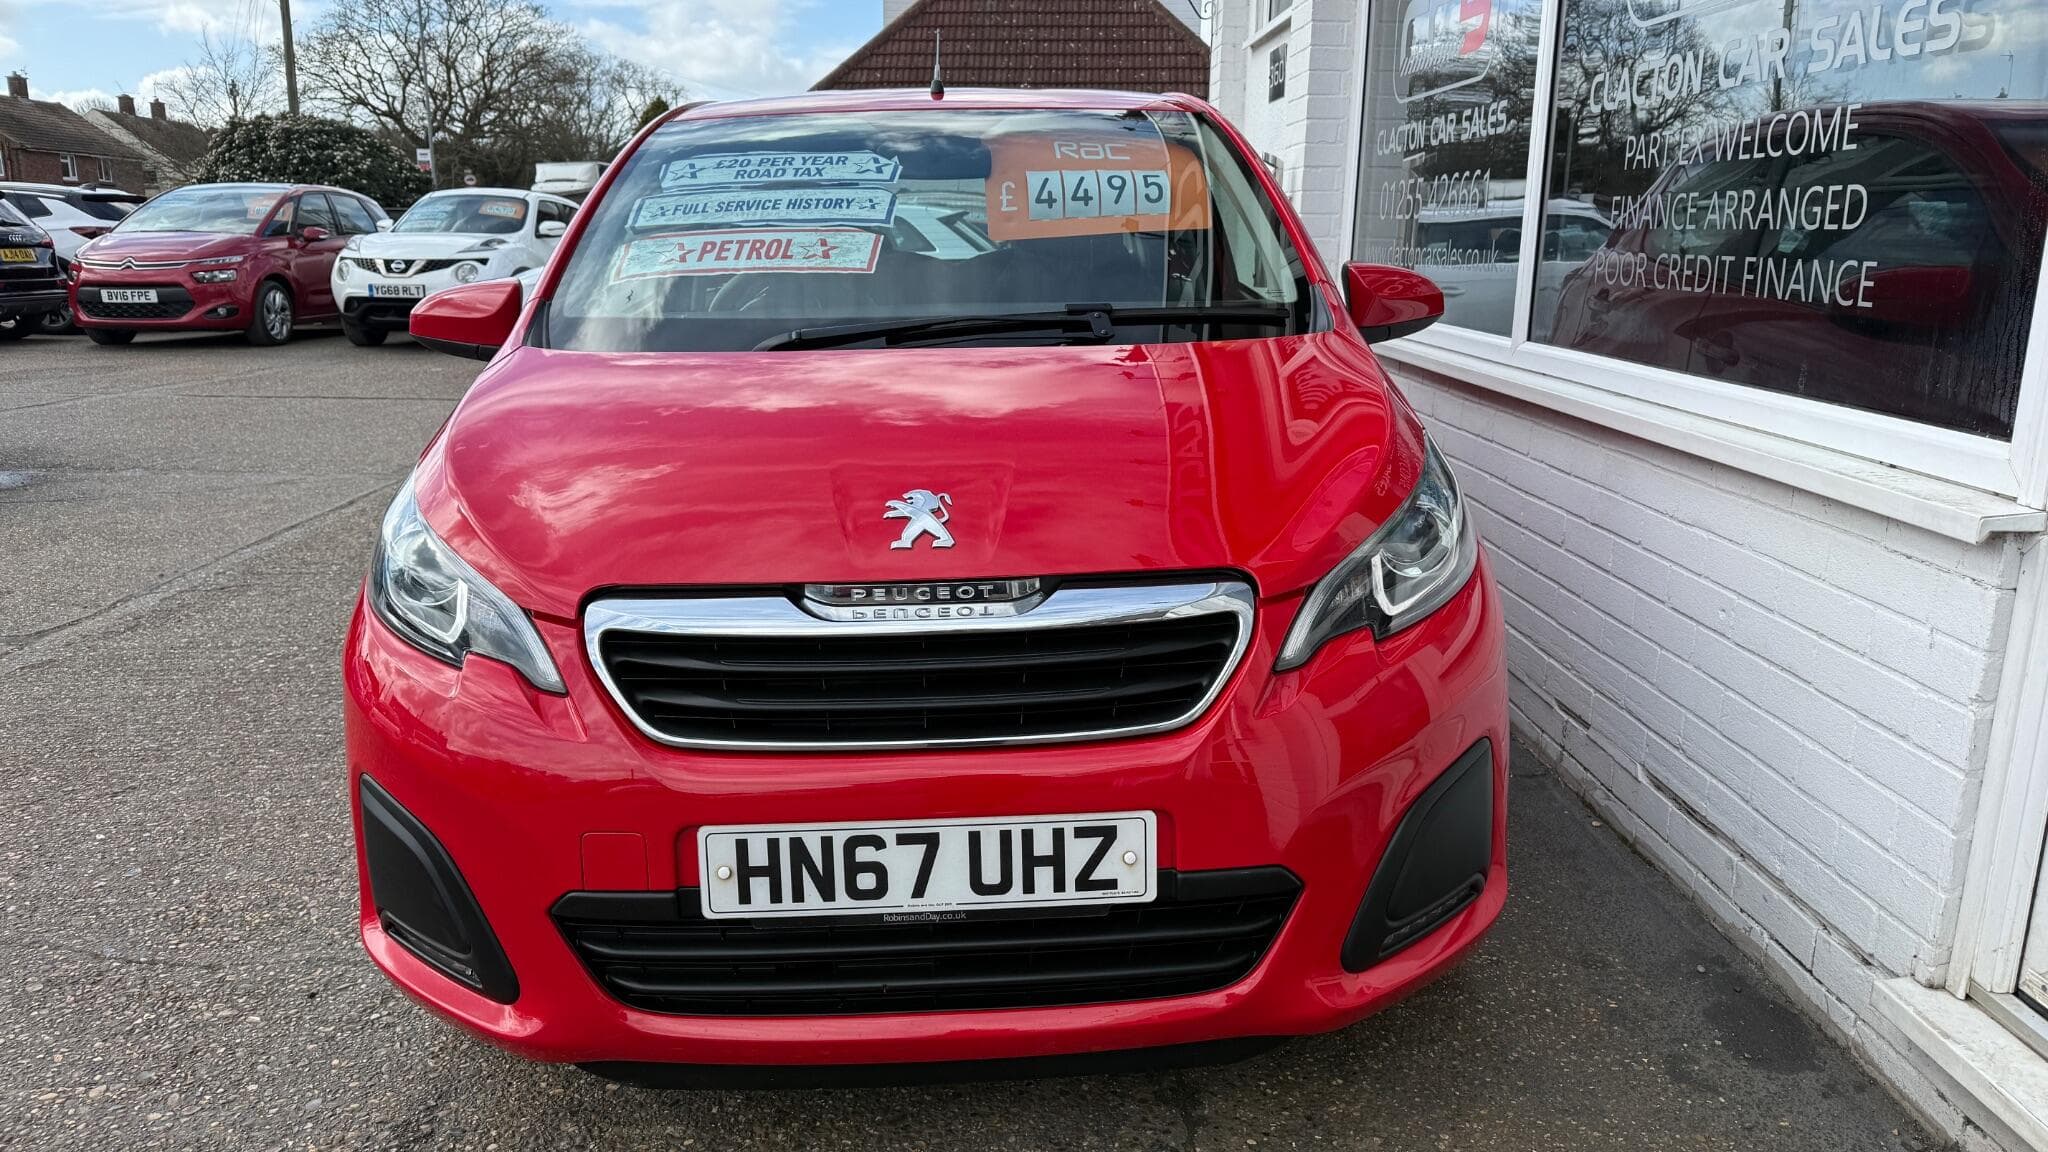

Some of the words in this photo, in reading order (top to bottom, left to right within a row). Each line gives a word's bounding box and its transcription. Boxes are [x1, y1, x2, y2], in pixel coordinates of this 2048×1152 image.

[1590, 50, 1704, 113] CLACTON
[1718, 27, 1792, 88] CAR
[1807, 0, 1963, 74] SALES
[1377, 119, 1427, 156] CLACTON
[1430, 112, 1457, 146] CAR
[1460, 100, 1508, 143] SALES
[1624, 128, 1672, 170] PART
[1679, 121, 1704, 165] EX
[1713, 103, 1864, 162] WELCOME
[712, 158, 749, 169] £20
[758, 156, 795, 167] PER
[801, 156, 849, 166] YEAR
[734, 168, 787, 180] ROAD
[792, 167, 827, 178] TAX
[672, 203, 710, 216] FULL
[715, 198, 782, 213] SERVICE
[786, 197, 856, 210] HISTORY
[999, 181, 1018, 212] £
[1034, 175, 1164, 209] 4495
[1380, 177, 1425, 220] 01255
[1427, 168, 1491, 214] 426661
[1610, 192, 1699, 230] FINANCE
[1703, 184, 1869, 231] ARRANGED
[696, 238, 795, 262] PETROL
[106, 290, 129, 301] BV16
[131, 290, 151, 301] FPE
[374, 285, 400, 296] YG68
[402, 286, 421, 296] RLT
[1594, 250, 1647, 289] POOR
[1653, 252, 1736, 295] CREDIT
[1741, 256, 1879, 308] FINANCE
[850, 585, 994, 601] PEUGEOT
[734, 832, 941, 905] HN67
[967, 825, 1119, 896] UHZ
